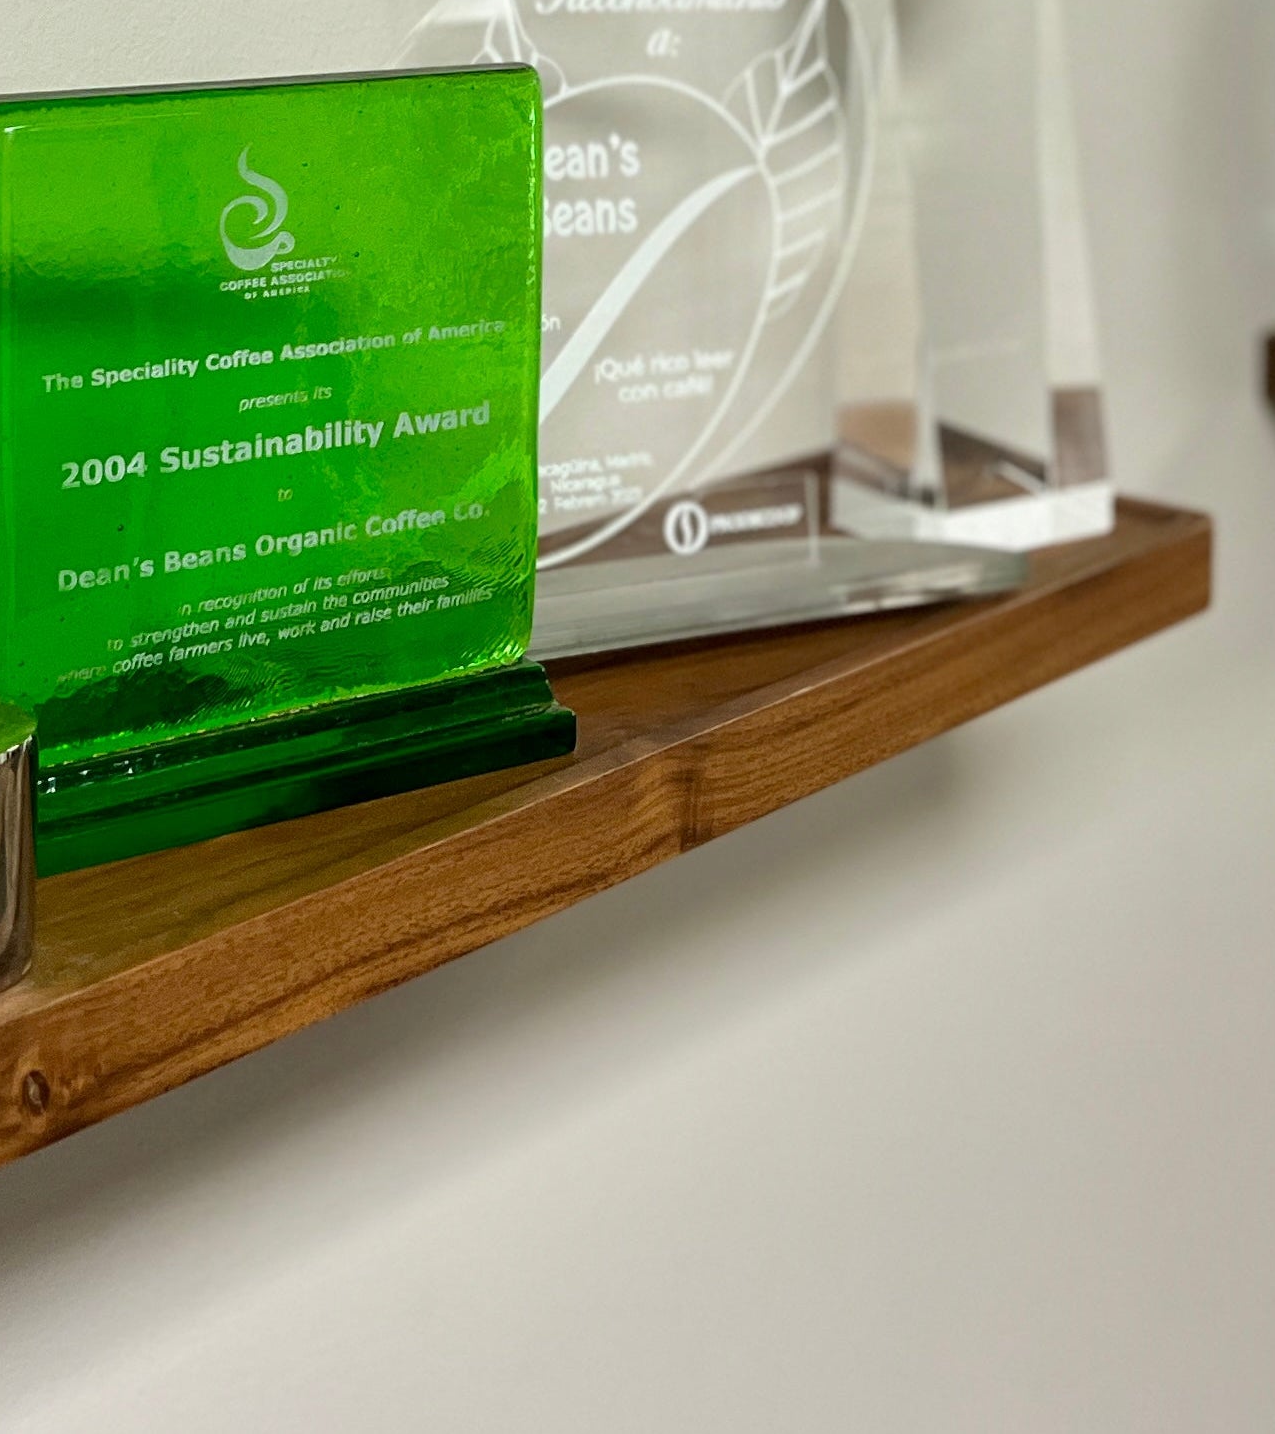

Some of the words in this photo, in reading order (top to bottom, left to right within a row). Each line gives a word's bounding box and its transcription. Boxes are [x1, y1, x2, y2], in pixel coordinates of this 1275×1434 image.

[646, 27, 681, 57] a:
[543, 132, 641, 182] ean's
[219, 276, 267, 292] COFFEE
[271, 255, 338, 273] SPECIALTY
[244, 291, 258, 300] OF
[263, 285, 310, 298] AMERICA
[42, 372, 84, 393] The
[91, 357, 199, 389] Speciality
[205, 348, 274, 371] Coffee
[279, 331, 396, 362] Association
[402, 327, 423, 344] of
[428, 318, 506, 341] America
[238, 390, 308, 414] presents
[313, 385, 333, 400] its
[61, 451, 148, 490] 2004
[160, 419, 385, 474] Sustainability
[393, 400, 491, 439] Award
[277, 488, 293, 502] to
[58, 556, 155, 592] Dean's
[164, 542, 247, 574] Beans
[255, 521, 357, 557] Organic
[365, 508, 446, 538] Coffee
[453, 502, 491, 522] Co.
[106, 637, 124, 652] to
[130, 618, 220, 649] strengthen
[225, 609, 257, 629] and
[261, 598, 316, 624] sustain
[323, 593, 348, 611] the
[352, 574, 450, 606] communities
[197, 584, 288, 613] recognition
[293, 577, 310, 595] of
[313, 574, 333, 591] its
[336, 565, 388, 586] efforts
[112, 649, 163, 675] coffee
[168, 636, 234, 663] farmers
[238, 631, 272, 648] live,
[277, 619, 317, 641] work
[319, 611, 352, 634] and
[354, 605, 393, 626] raise
[397, 599, 435, 619] their
[437, 586, 494, 610] families
